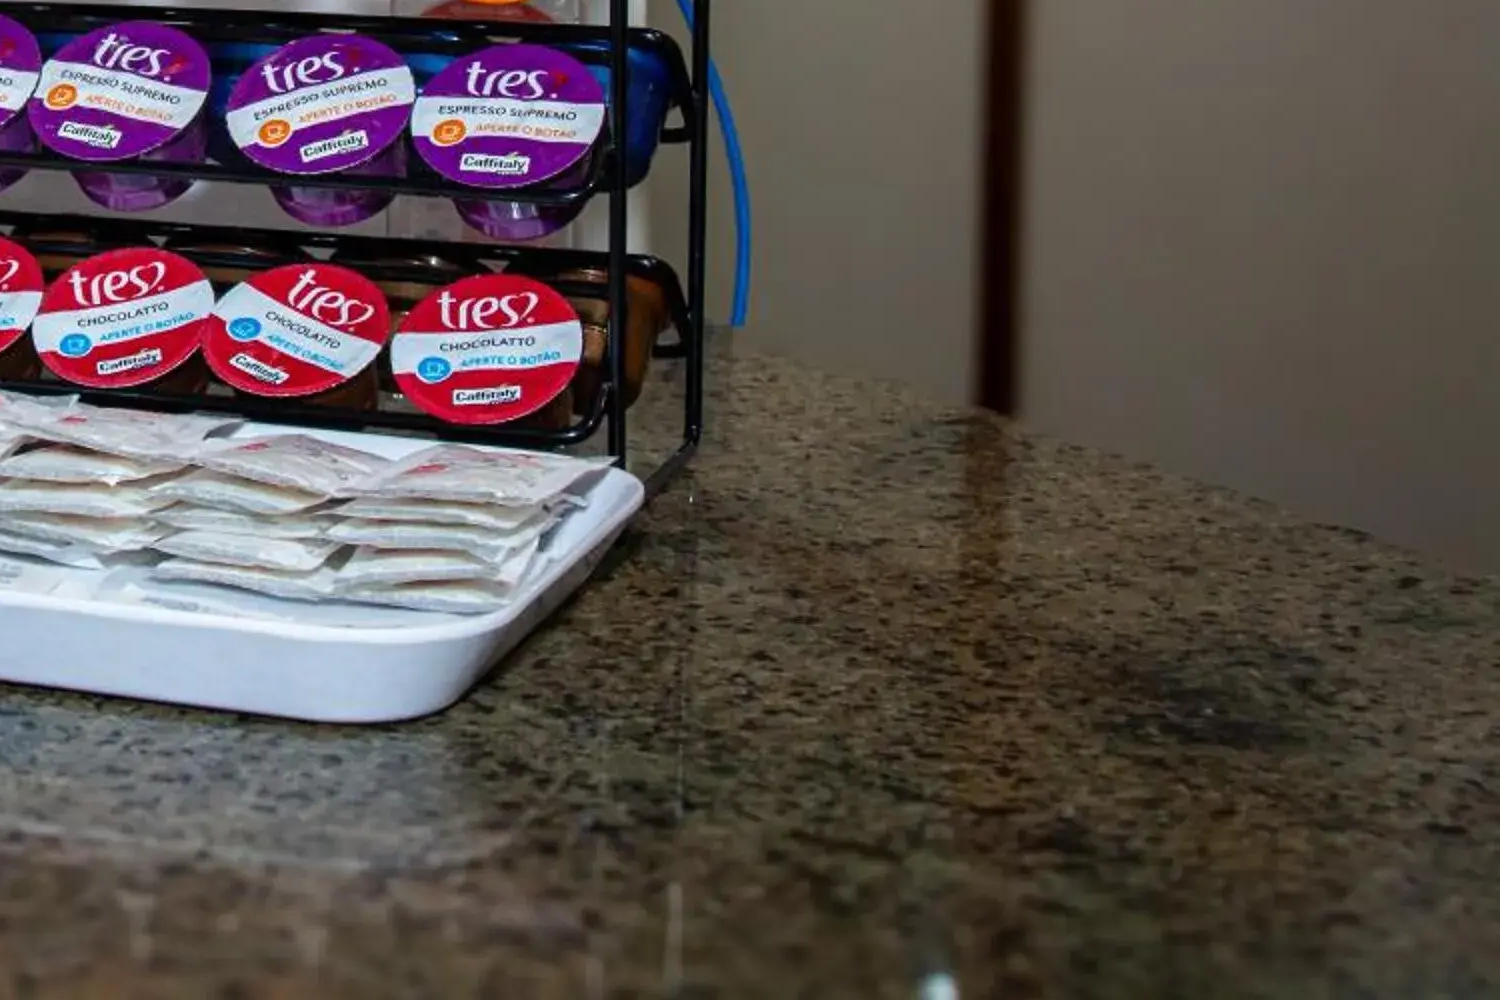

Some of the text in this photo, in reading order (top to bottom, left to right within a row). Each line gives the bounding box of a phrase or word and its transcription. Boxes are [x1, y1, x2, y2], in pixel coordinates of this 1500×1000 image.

[94, 33, 171, 76] tres
[261, 51, 345, 92] tres
[467, 61, 548, 99] tres
[61, 70, 180, 104] ESPRESSO SUPREMO
[253, 78, 388, 121] ESPRESSO SUPREMO
[439, 106, 576, 120] ESPRESSO SUPREMO
[63, 123, 116, 145] Caffitaly
[303, 136, 365, 157] Caffitaly
[464, 156, 526, 170] Caffitaly
[68, 262, 165, 305] tres
[77, 301, 168, 327] CHOCOLATTO
[437, 291, 538, 329] tres
[265, 311, 341, 349] CHOCOLATTO
[440, 337, 535, 351] CHOCOLATTO
[100, 353, 158, 371] Caffitaly
[455, 389, 517, 401] Caffitaly
